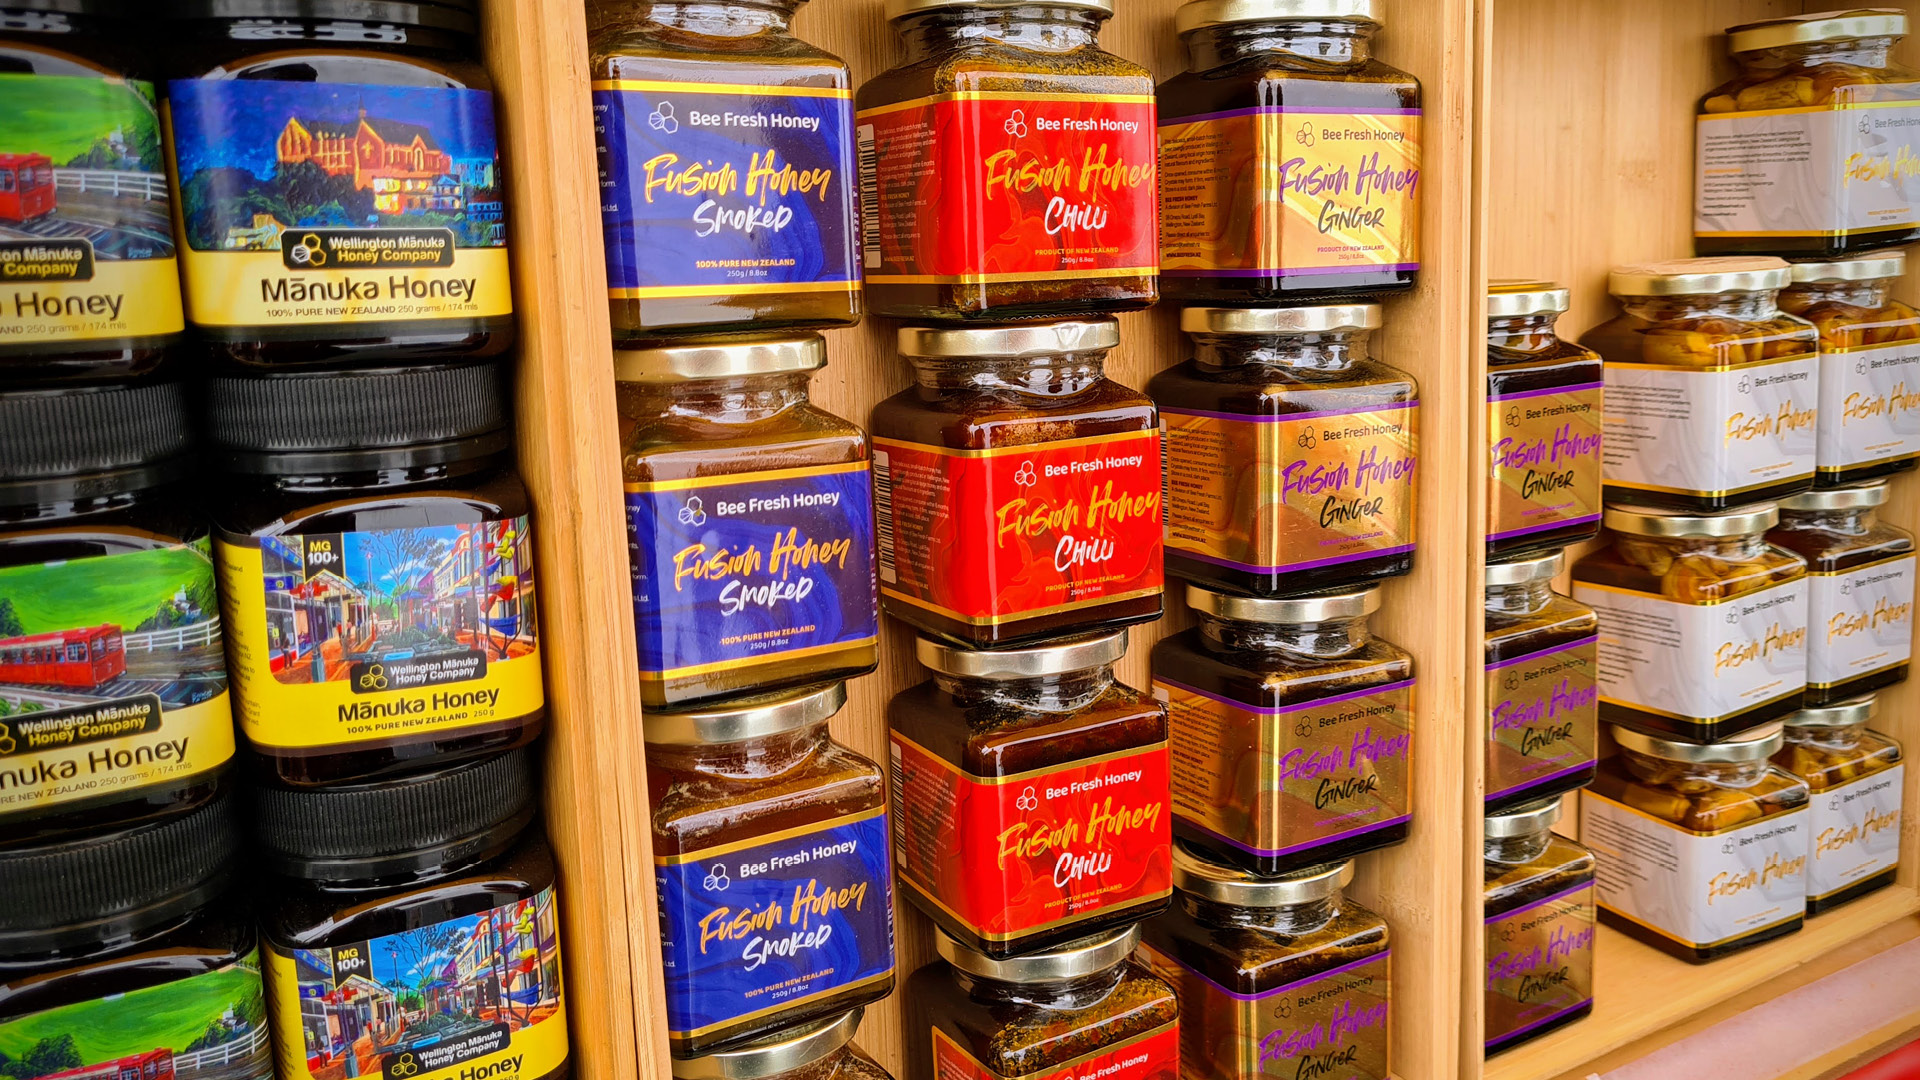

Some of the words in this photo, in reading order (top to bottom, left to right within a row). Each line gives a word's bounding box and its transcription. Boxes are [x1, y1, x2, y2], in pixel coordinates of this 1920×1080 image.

[690, 111, 721, 126] Bee
[724, 112, 768, 127] Fresh
[771, 113, 820, 132] Honey
[1036, 117, 1060, 131] Bee
[1063, 117, 1098, 131] Fresh
[1100, 118, 1139, 134] Honey
[1323, 129, 1342, 140] Bee
[1344, 129, 1372, 140] Fresh
[1375, 130, 1405, 143] Honey
[745, 149, 832, 206] Honey
[1079, 143, 1156, 202] Honey
[1355, 151, 1419, 204] Honey
[23, 247, 83, 262] Mānuka
[329, 236, 396, 251] Wellington
[398, 235, 445, 248] Mānuka
[1035, 248, 1065, 256] PRODUCT
[1091, 246, 1119, 254] ZEALAND
[337, 249, 379, 264] Honey
[382, 249, 441, 263] Company
[695, 260, 718, 269] 100%
[719, 259, 740, 268] PURE
[741, 259, 759, 267] NEW
[760, 258, 795, 267] ZEALAND
[1061, 256, 1076, 264] 250g
[4, 262, 78, 277] Company
[727, 269, 745, 278] 250g
[261, 277, 380, 302] Mānuka
[389, 276, 477, 302] Honey
[15, 292, 124, 321] Honey
[266, 309, 293, 317] 100%
[296, 308, 323, 317] PURE
[326, 307, 348, 316] NEW
[351, 306, 395, 315] ZEALAND
[398, 305, 413, 313] 250
[415, 305, 440, 314] grams
[449, 303, 462, 311] 174
[1526, 408, 1542, 420] Bee
[1543, 405, 1565, 417] Fresh
[1566, 402, 1592, 414] Honey
[1323, 429, 1342, 441] Bee
[1344, 426, 1370, 439] Fresh
[1372, 423, 1403, 437] Honey
[1045, 463, 1068, 477] Bee
[1071, 458, 1104, 474] Fresh
[1106, 454, 1143, 473] Honey
[1355, 445, 1417, 496] Honey
[717, 500, 746, 516] Bee
[749, 496, 791, 513] Fresh
[793, 491, 840, 509] Honey
[1087, 480, 1161, 537] Honey
[307, 551, 339, 565] 100+
[309, 541, 331, 552] MG
[768, 527, 852, 580] Honey
[743, 632, 763, 642] PURE
[764, 629, 781, 639] NEW
[782, 624, 816, 637] ZEALAND
[390, 662, 442, 678] Wellington
[443, 657, 479, 671] Mānuka
[396, 672, 428, 685] Honey
[430, 666, 476, 682] Company
[337, 699, 427, 723] Mānuka
[432, 688, 501, 711] Honey
[1319, 716, 1338, 728] Bee
[1339, 711, 1365, 724] Fresh
[1366, 703, 1396, 719] Honey
[18, 713, 95, 736] Wellington
[96, 703, 151, 723] Mānuka
[28, 730, 75, 747] Honey
[78, 716, 147, 737] Company
[346, 725, 374, 734] 100%
[375, 721, 401, 731] PURE
[402, 718, 425, 728] NEW
[426, 711, 469, 726] ZEALAND
[473, 710, 488, 718] 250
[88, 736, 190, 774] Honey
[18, 790, 44, 801] NEW
[47, 780, 97, 798] ZEALAND
[100, 777, 118, 787] 250
[120, 771, 149, 784] grams
[158, 766, 174, 775] 174
[1046, 787, 1069, 800] Bee
[1071, 778, 1103, 795] Fresh
[1105, 770, 1142, 789] Honey
[1086, 796, 1162, 850] Honey
[740, 862, 768, 878] Bee
[771, 853, 810, 869] Fresh
[813, 840, 857, 861] Honey
[790, 879, 868, 930] Honey
[336, 958, 366, 973] 100+
[338, 947, 359, 960] MG
[1298, 996, 1317, 1007] Bee
[1317, 986, 1344, 1003] Fresh
[1345, 974, 1375, 992] Honey
[418, 1040, 467, 1061] Wellington
[468, 1030, 503, 1046] Mānuka
[425, 1054, 455, 1068] Honey
[456, 1039, 500, 1060] Company
[460, 1053, 524, 1080] Honey
[1097, 1063, 1121, 1078] Fresh
[1122, 1053, 1149, 1069] Honey
